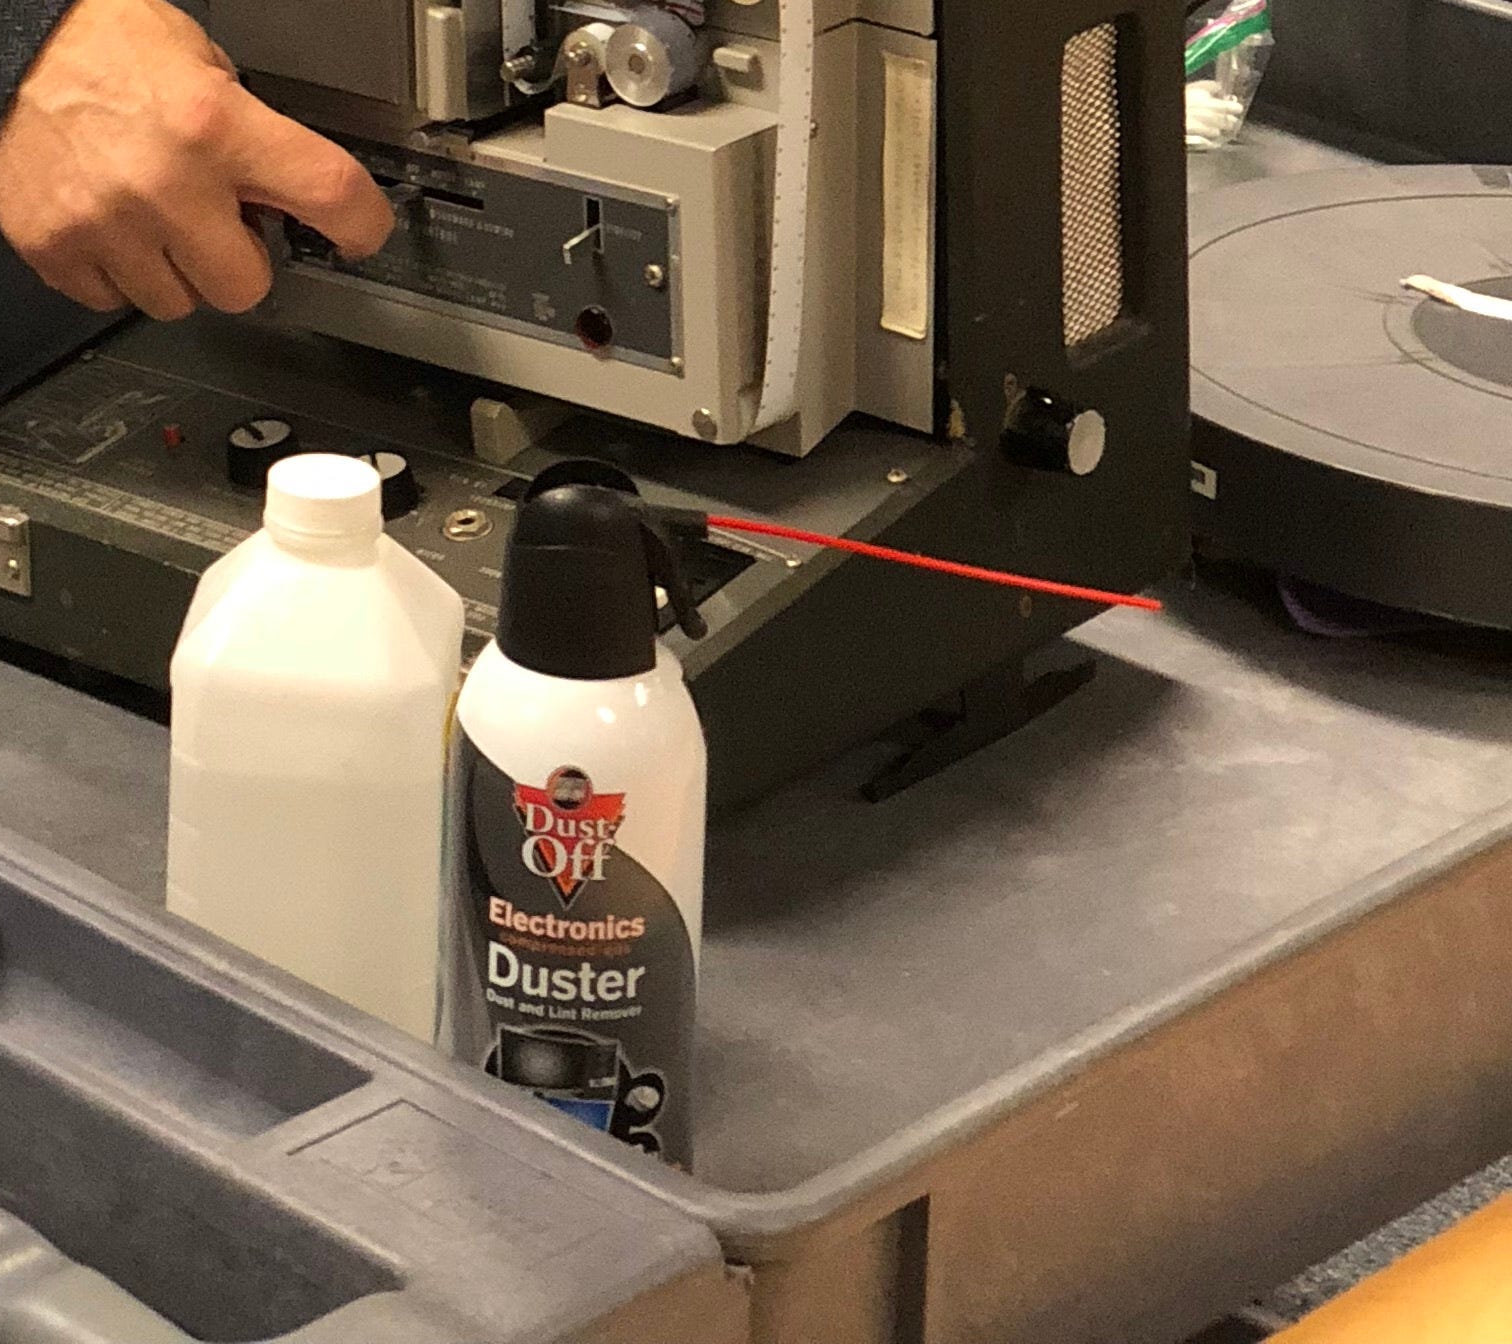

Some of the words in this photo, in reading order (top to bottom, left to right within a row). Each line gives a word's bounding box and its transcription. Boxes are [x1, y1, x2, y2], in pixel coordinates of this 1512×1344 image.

[521, 834, 616, 881] Off
[489, 895, 646, 940] Electronics
[488, 940, 646, 1002] Duster
[518, 1002, 545, 1017] and
[548, 1005, 576, 1020] Lint
